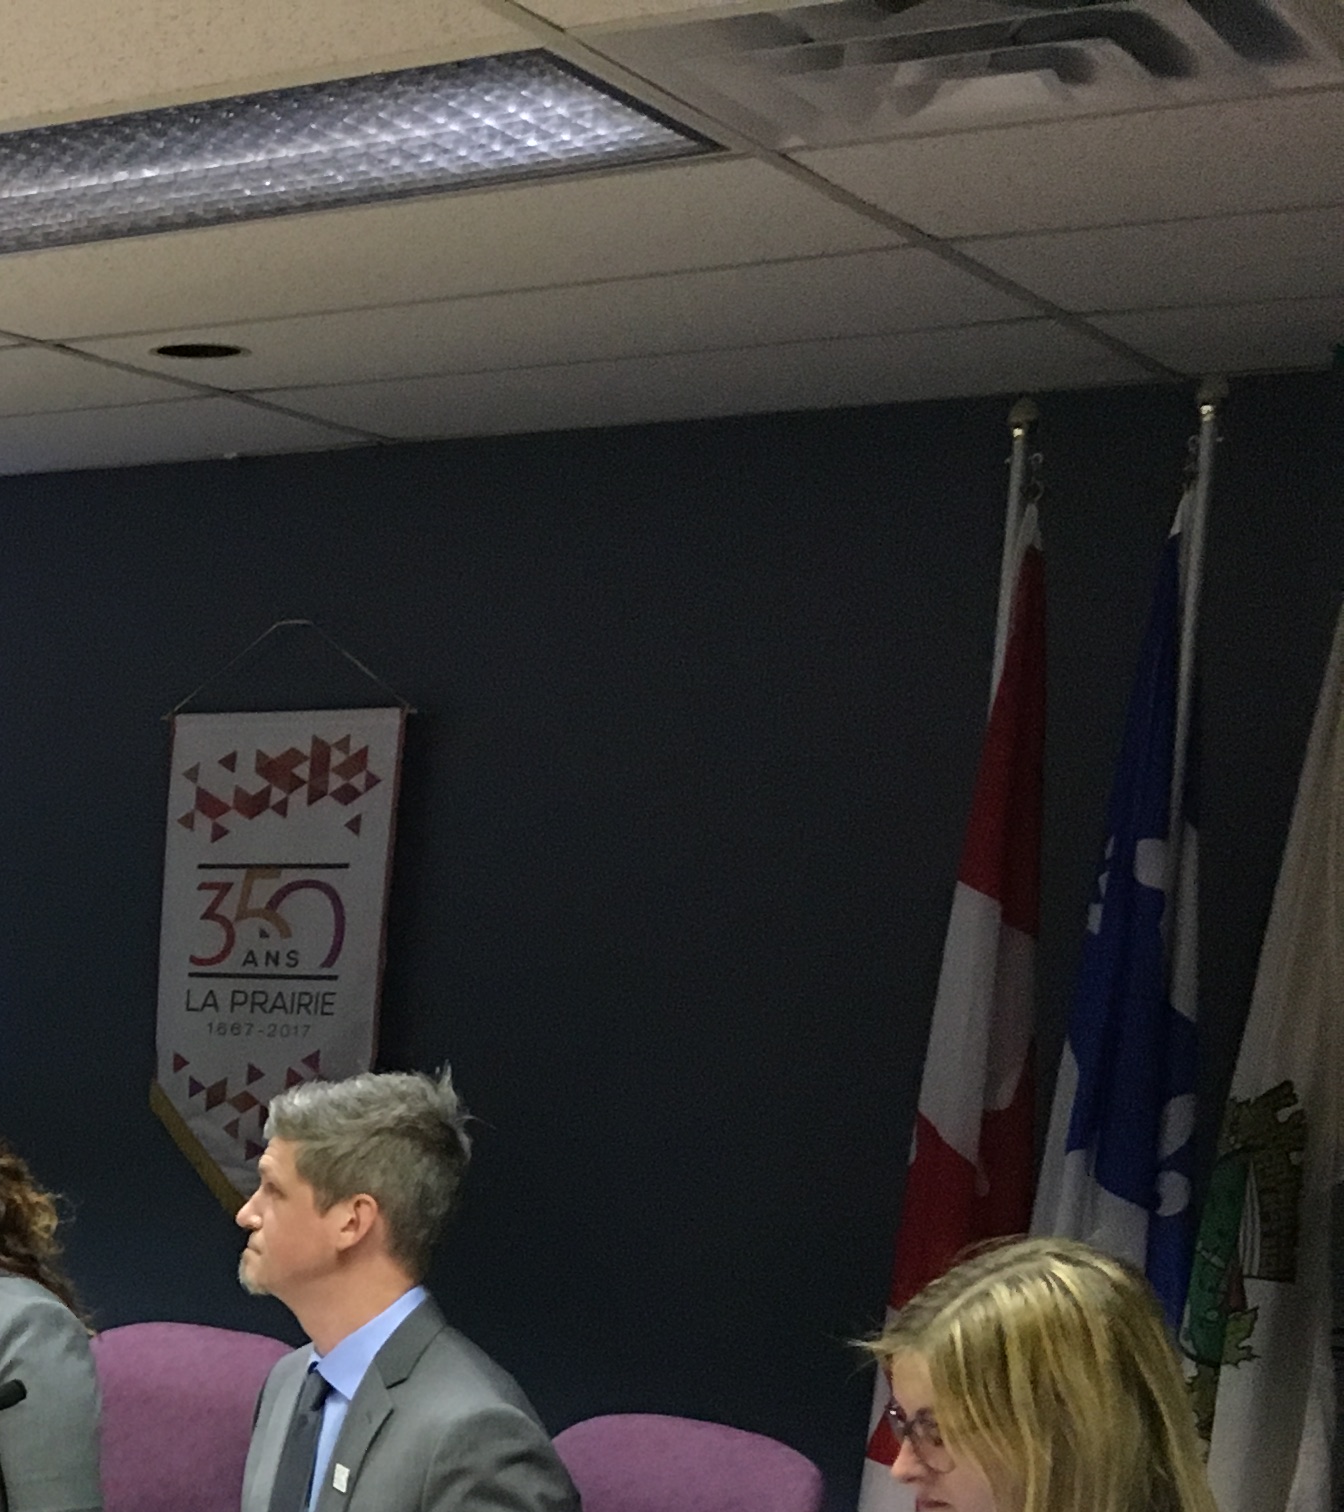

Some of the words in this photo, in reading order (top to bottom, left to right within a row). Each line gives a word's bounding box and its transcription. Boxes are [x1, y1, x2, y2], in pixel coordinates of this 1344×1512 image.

[189, 868, 346, 969] 350
[242, 949, 300, 969] ANS
[185, 989, 220, 1013] LA
[229, 990, 337, 1016] PRAIRIE
[207, 1021, 312, 1038] 1667-2017
